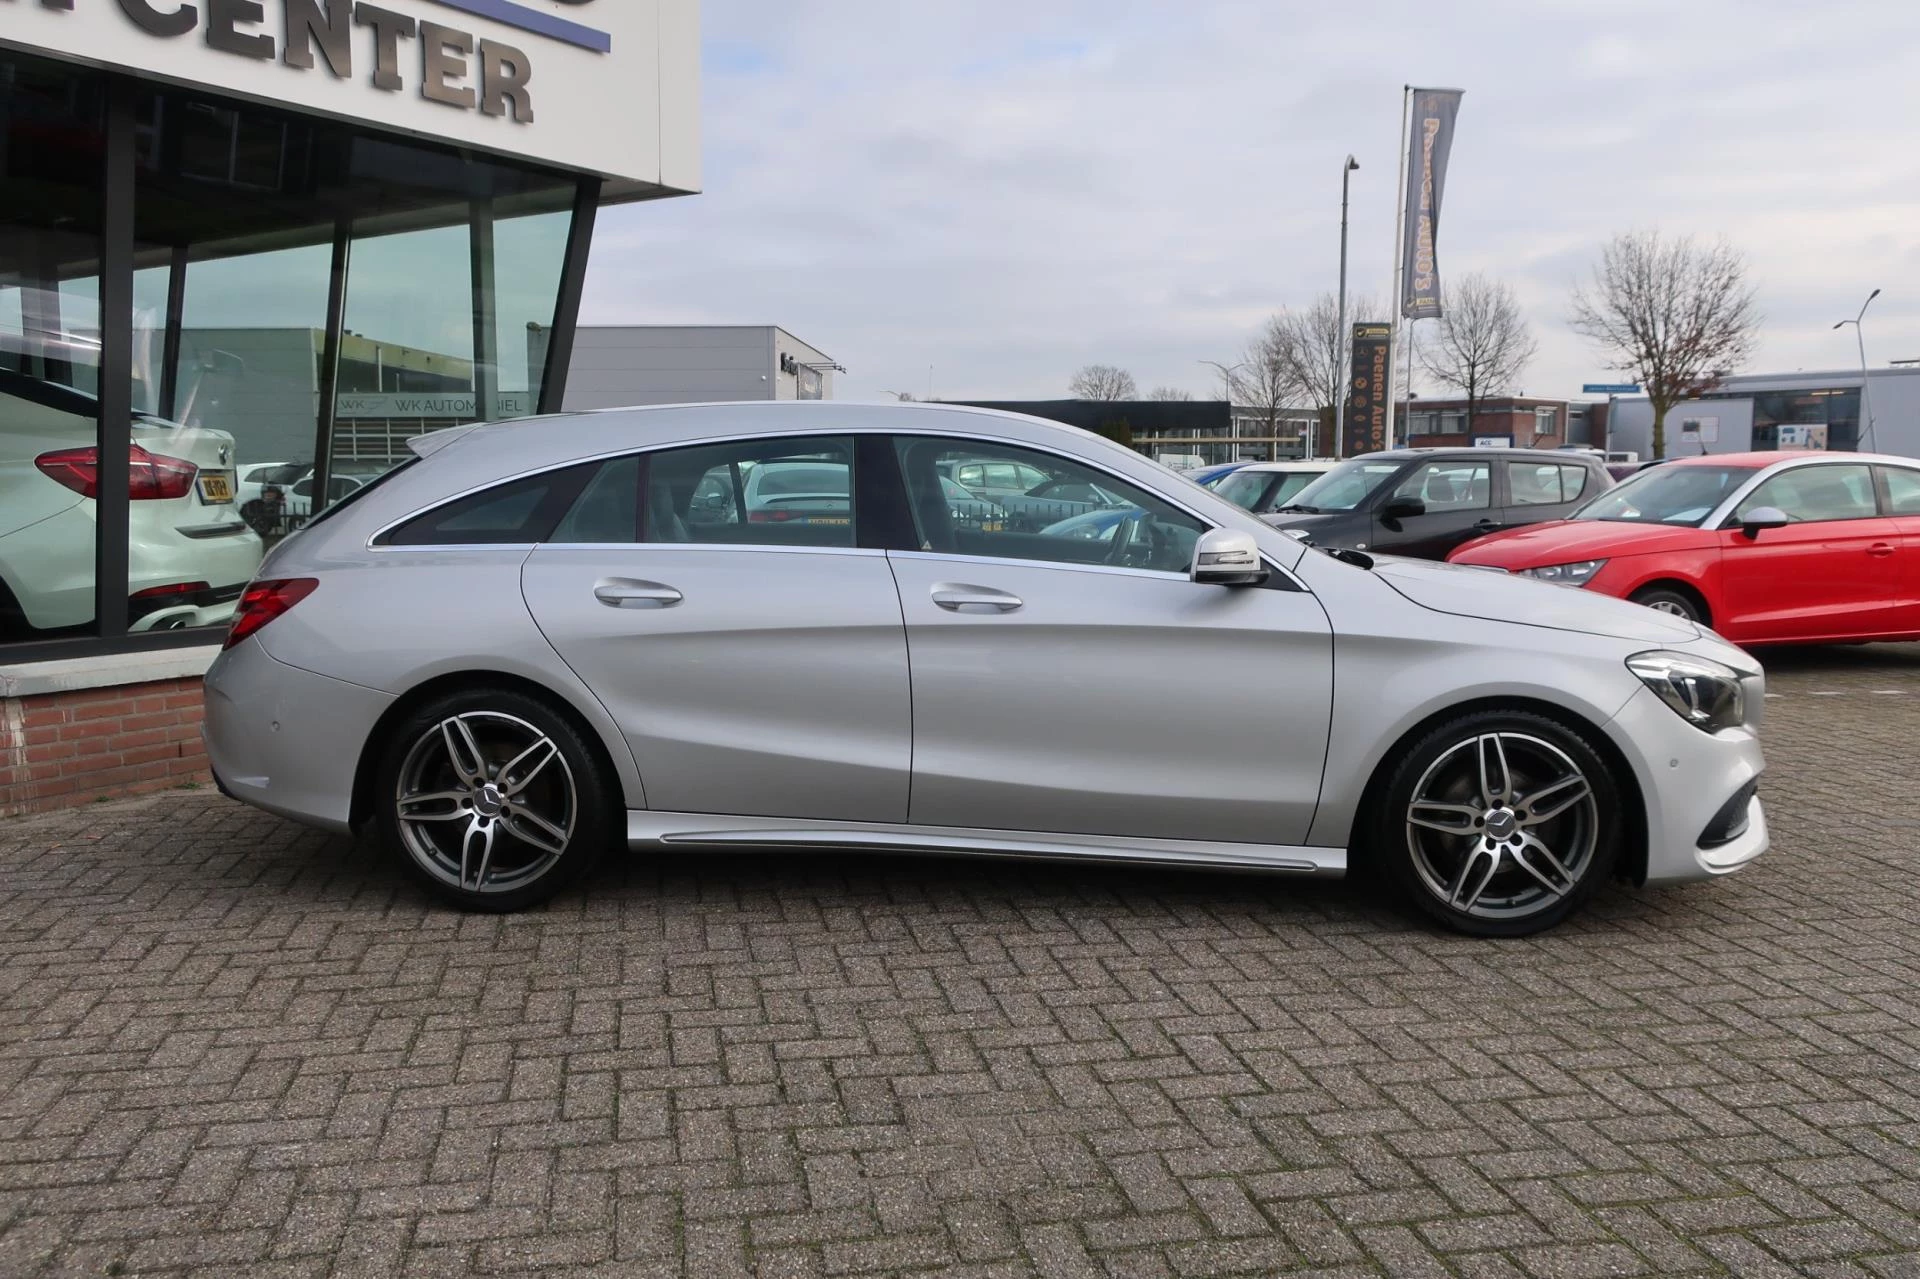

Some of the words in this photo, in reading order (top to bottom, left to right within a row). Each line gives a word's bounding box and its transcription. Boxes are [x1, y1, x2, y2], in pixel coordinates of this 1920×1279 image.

[1372, 345, 1387, 401] Paenen
[395, 400, 421, 412] WK
[423, 399, 522, 412] AUTOMIEL
[1371, 405, 1385, 451] Auto's
